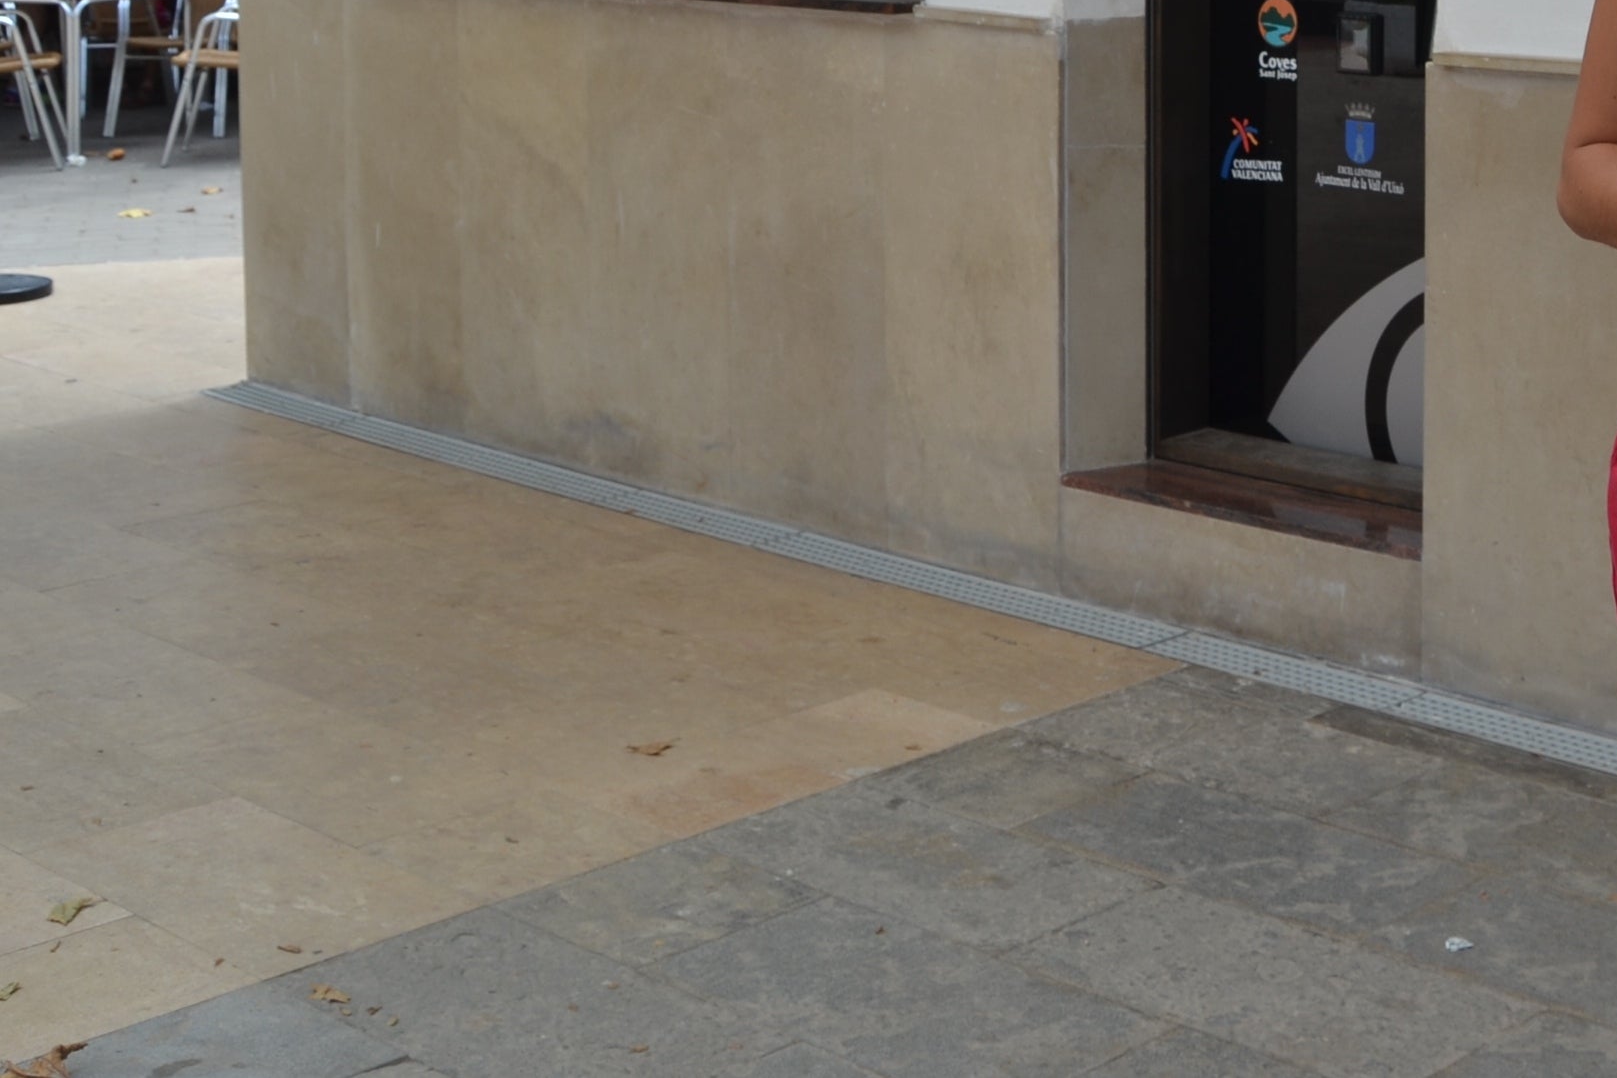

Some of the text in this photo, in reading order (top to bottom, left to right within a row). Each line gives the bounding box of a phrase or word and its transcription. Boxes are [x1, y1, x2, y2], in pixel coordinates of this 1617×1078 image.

[1258, 50, 1298, 71] Coves
[1232, 158, 1282, 171] COMUNITAT
[1231, 168, 1284, 182] VALENCIANA
